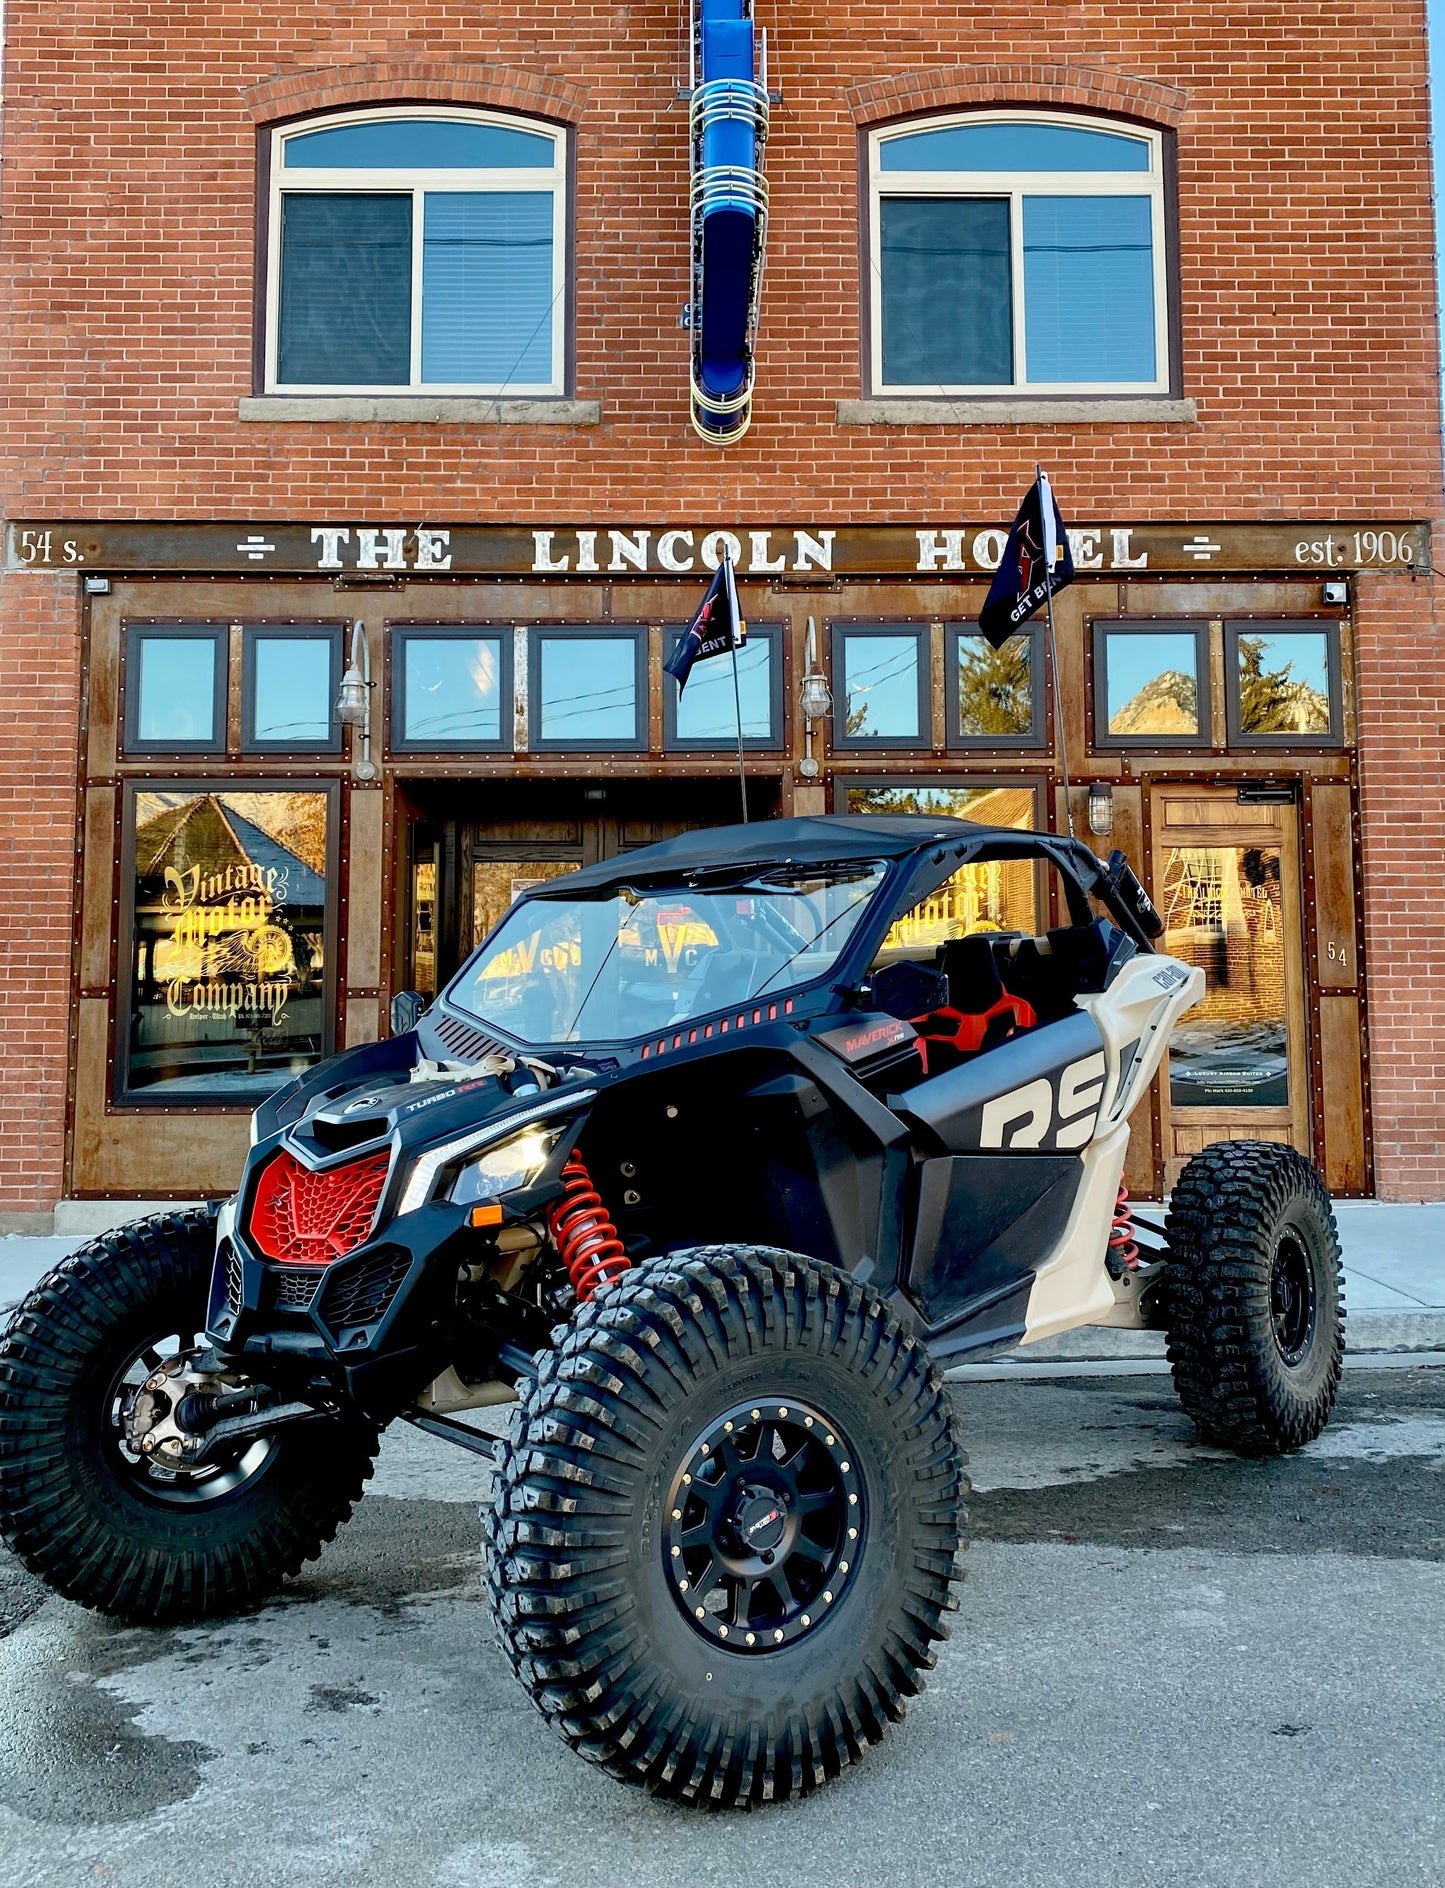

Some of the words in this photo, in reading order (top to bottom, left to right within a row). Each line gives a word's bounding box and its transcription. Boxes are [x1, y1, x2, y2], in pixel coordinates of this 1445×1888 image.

[21, 530, 53, 563] 54
[62, 540, 85, 563] s.
[310, 527, 452, 570] THE
[531, 530, 837, 572] LINCOLN
[915, 528, 1148, 572] HOEL
[1295, 534, 1344, 567] est.
[1352, 531, 1413, 563] 1906
[1010, 596, 1034, 623] GET
[162, 863, 279, 912] Vintage
[166, 894, 273, 960] Motor
[1328, 941, 1347, 967] 54
[166, 975, 287, 1026] Company
[845, 1020, 903, 1053] MAVERICK
[406, 1089, 456, 1112] TURBO
[980, 1051, 1106, 1148] RS
